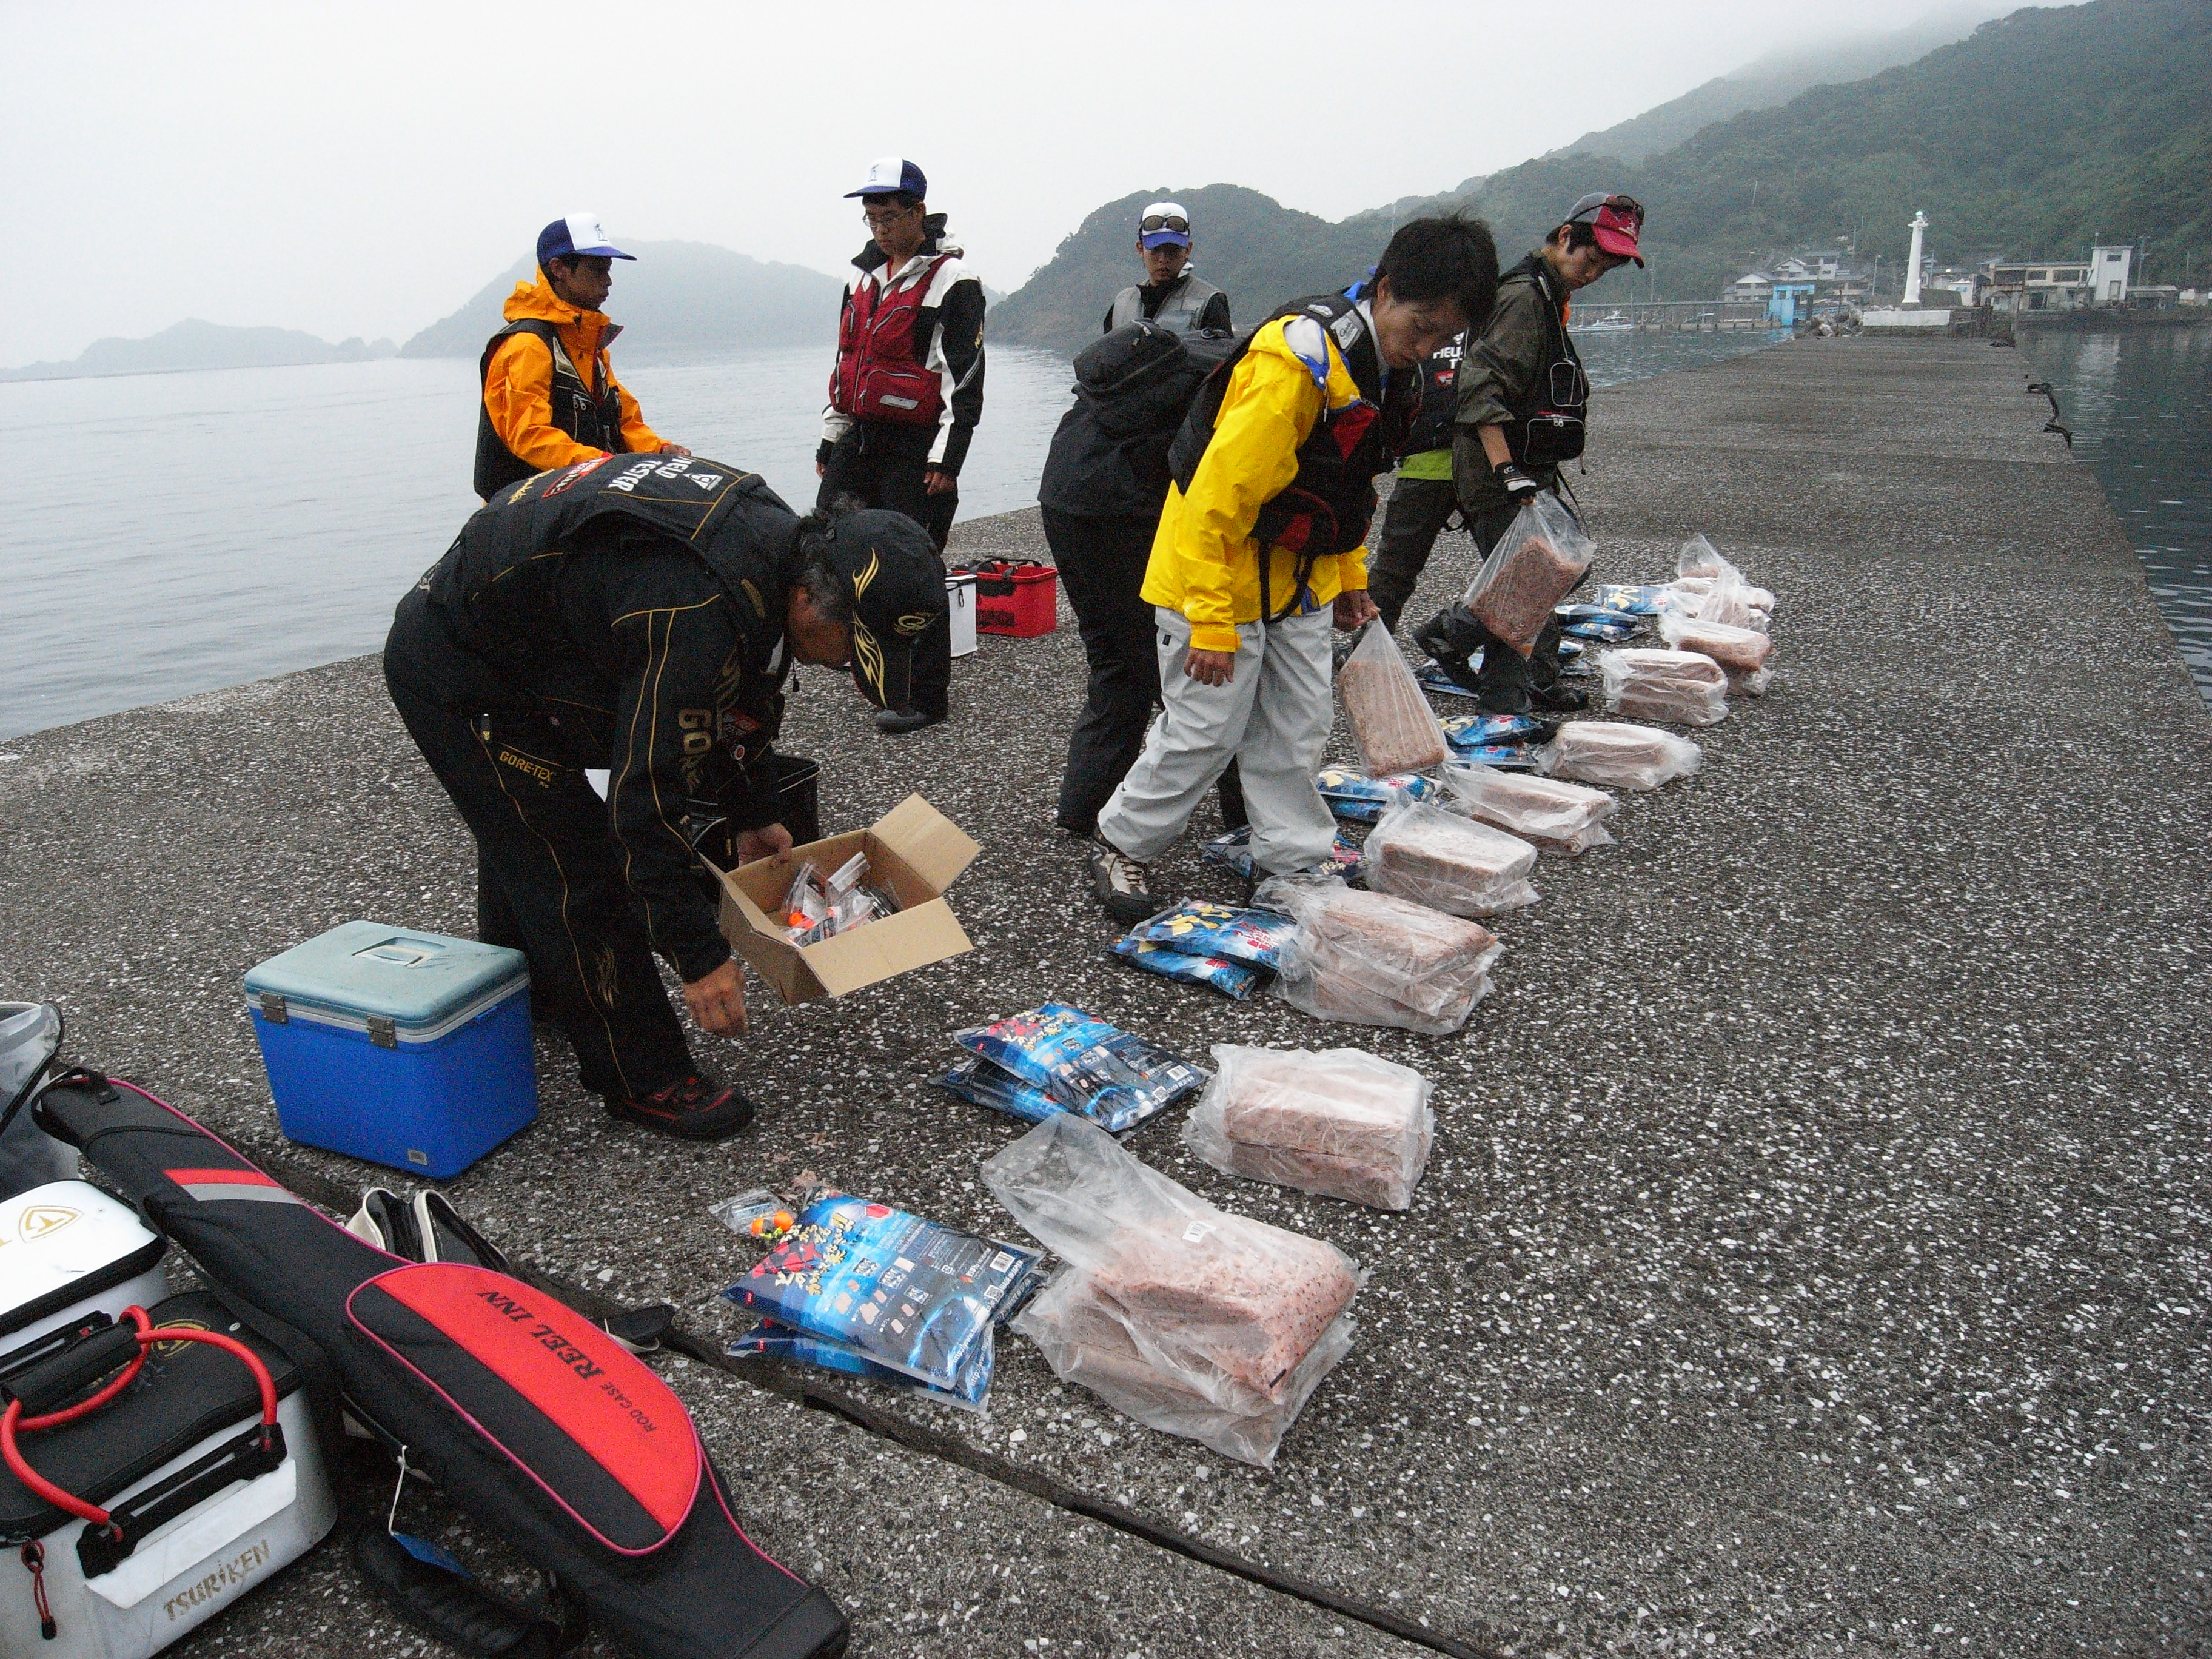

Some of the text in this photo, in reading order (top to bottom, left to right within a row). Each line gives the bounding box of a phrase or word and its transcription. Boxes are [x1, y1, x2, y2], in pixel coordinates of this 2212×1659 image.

[608, 461, 662, 492] TESTER
[500, 751, 553, 782] GORE-TEX
[478, 1290, 657, 1433] ROD CASE REEL INN
